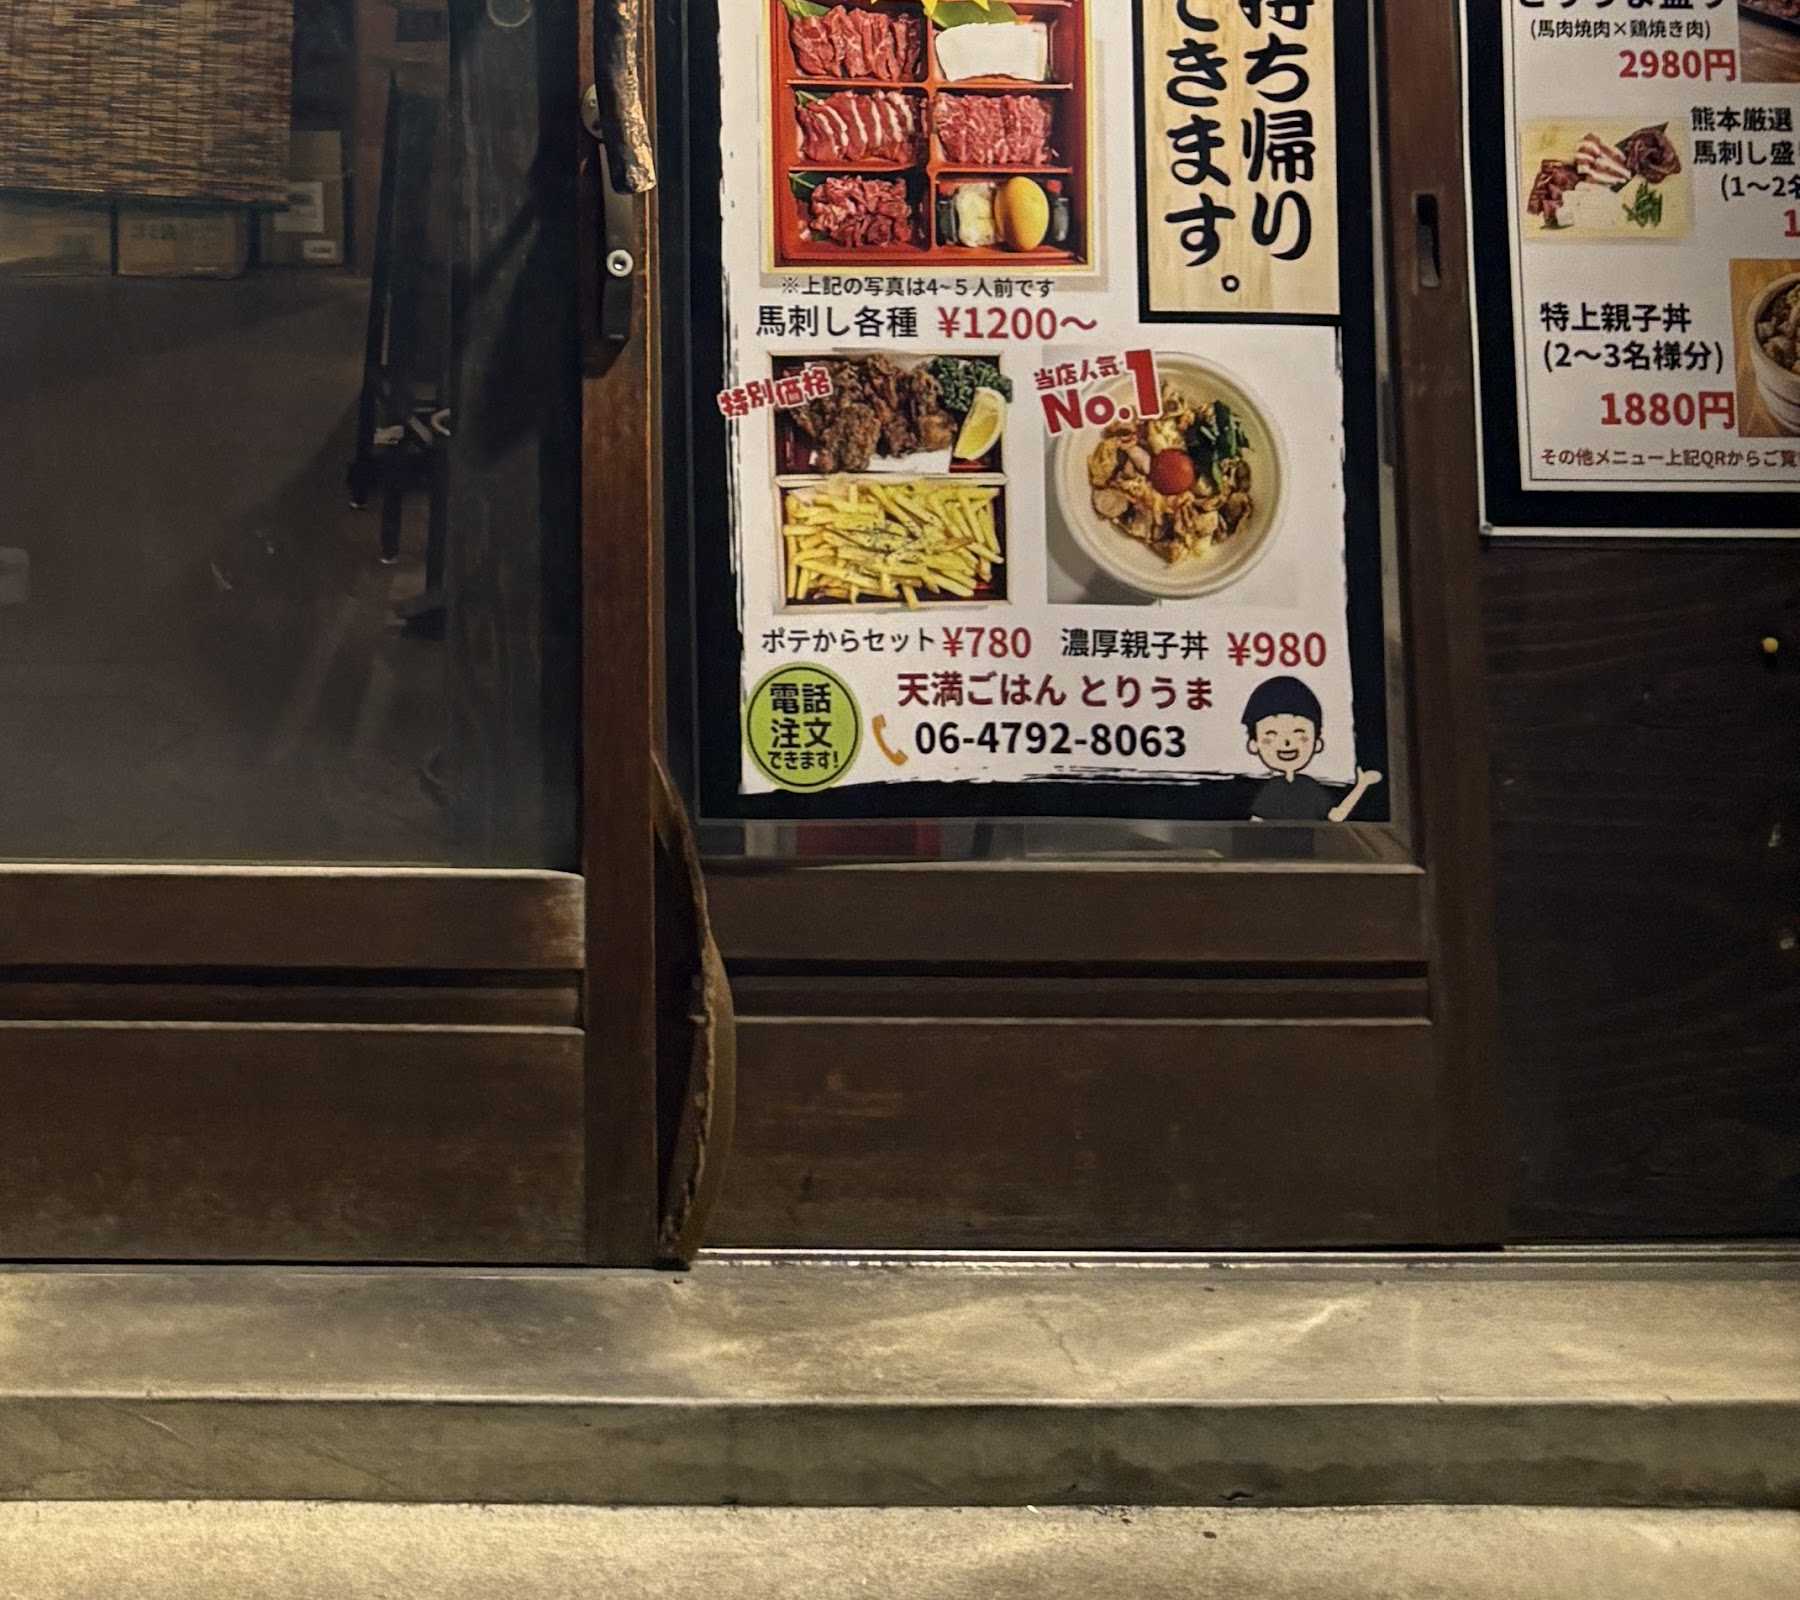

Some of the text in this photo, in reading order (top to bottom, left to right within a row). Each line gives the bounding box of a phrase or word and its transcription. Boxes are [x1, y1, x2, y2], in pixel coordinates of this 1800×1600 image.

[1618, 48, 1737, 82] 2980円
[1690, 106, 1793, 132] 熊本厳選
[756, 304, 918, 338] 馬刺し各種
[1540, 301, 1693, 333] 特上親子丼
[1034, 355, 1120, 390] 当店人気
[1544, 340, 1724, 374] (2〜3名様分)
[720, 368, 831, 418] 特別価格
[1041, 349, 1159, 434] No.1
[1601, 390, 1736, 430] 1880円
[762, 627, 1032, 659] ポテからセット ¥780
[1061, 628, 1328, 667] 濃厚親子丼 ¥980
[770, 683, 831, 714] 電話
[898, 673, 1214, 710] 天満ごはん とりうま
[770, 717, 833, 749] 注文
[915, 721, 1187, 759] 06-4792-8063
[767, 750, 839, 770] できます!
